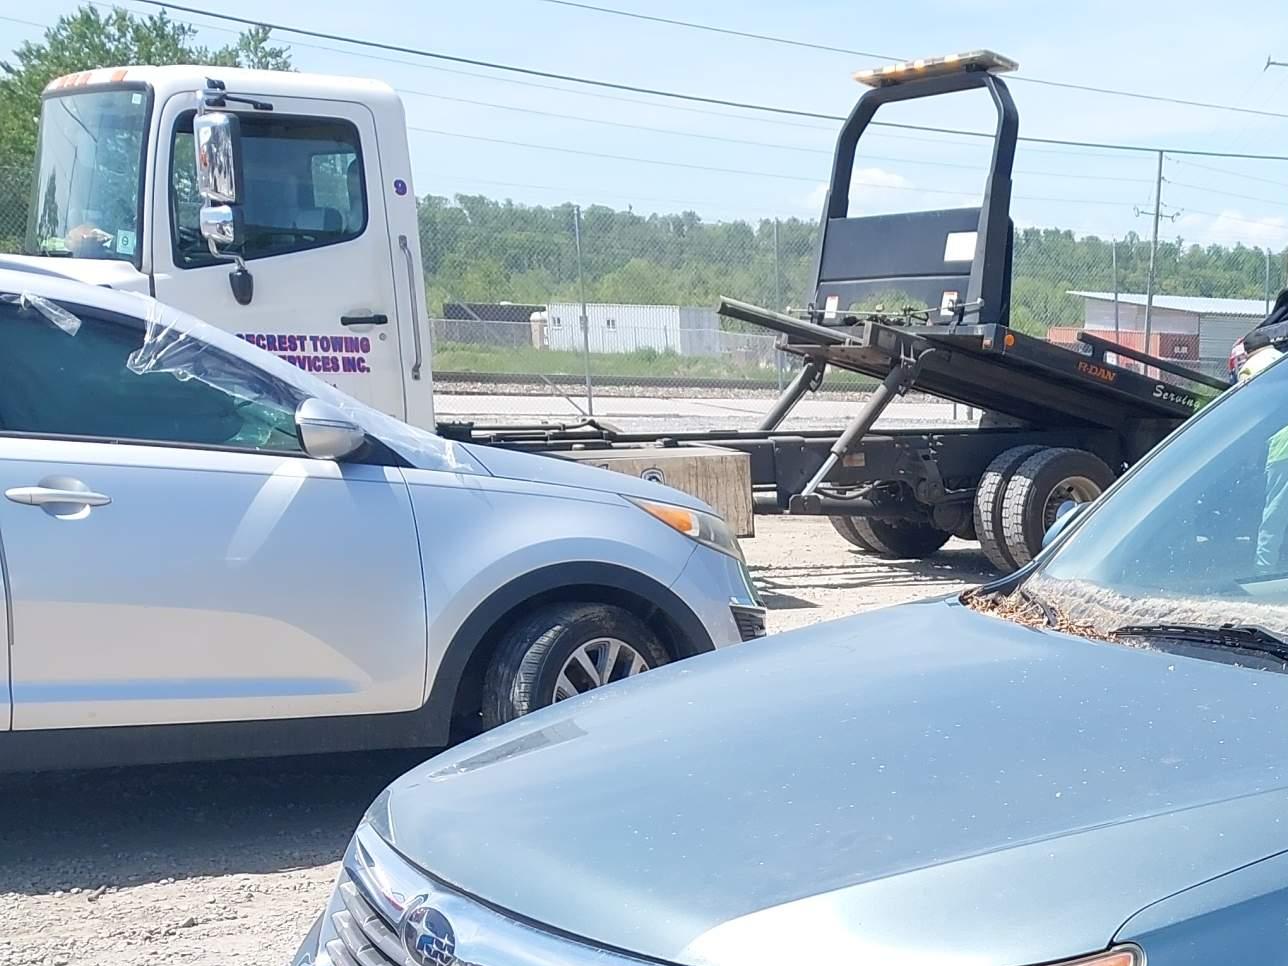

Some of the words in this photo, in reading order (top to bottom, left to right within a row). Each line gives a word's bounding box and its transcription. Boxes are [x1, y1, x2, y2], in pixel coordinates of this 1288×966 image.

[394, 179, 407, 196] 9
[310, 335, 371, 353] TOWING
[342, 356, 371, 373] INC.
[1153, 384, 1200, 412] Serving
